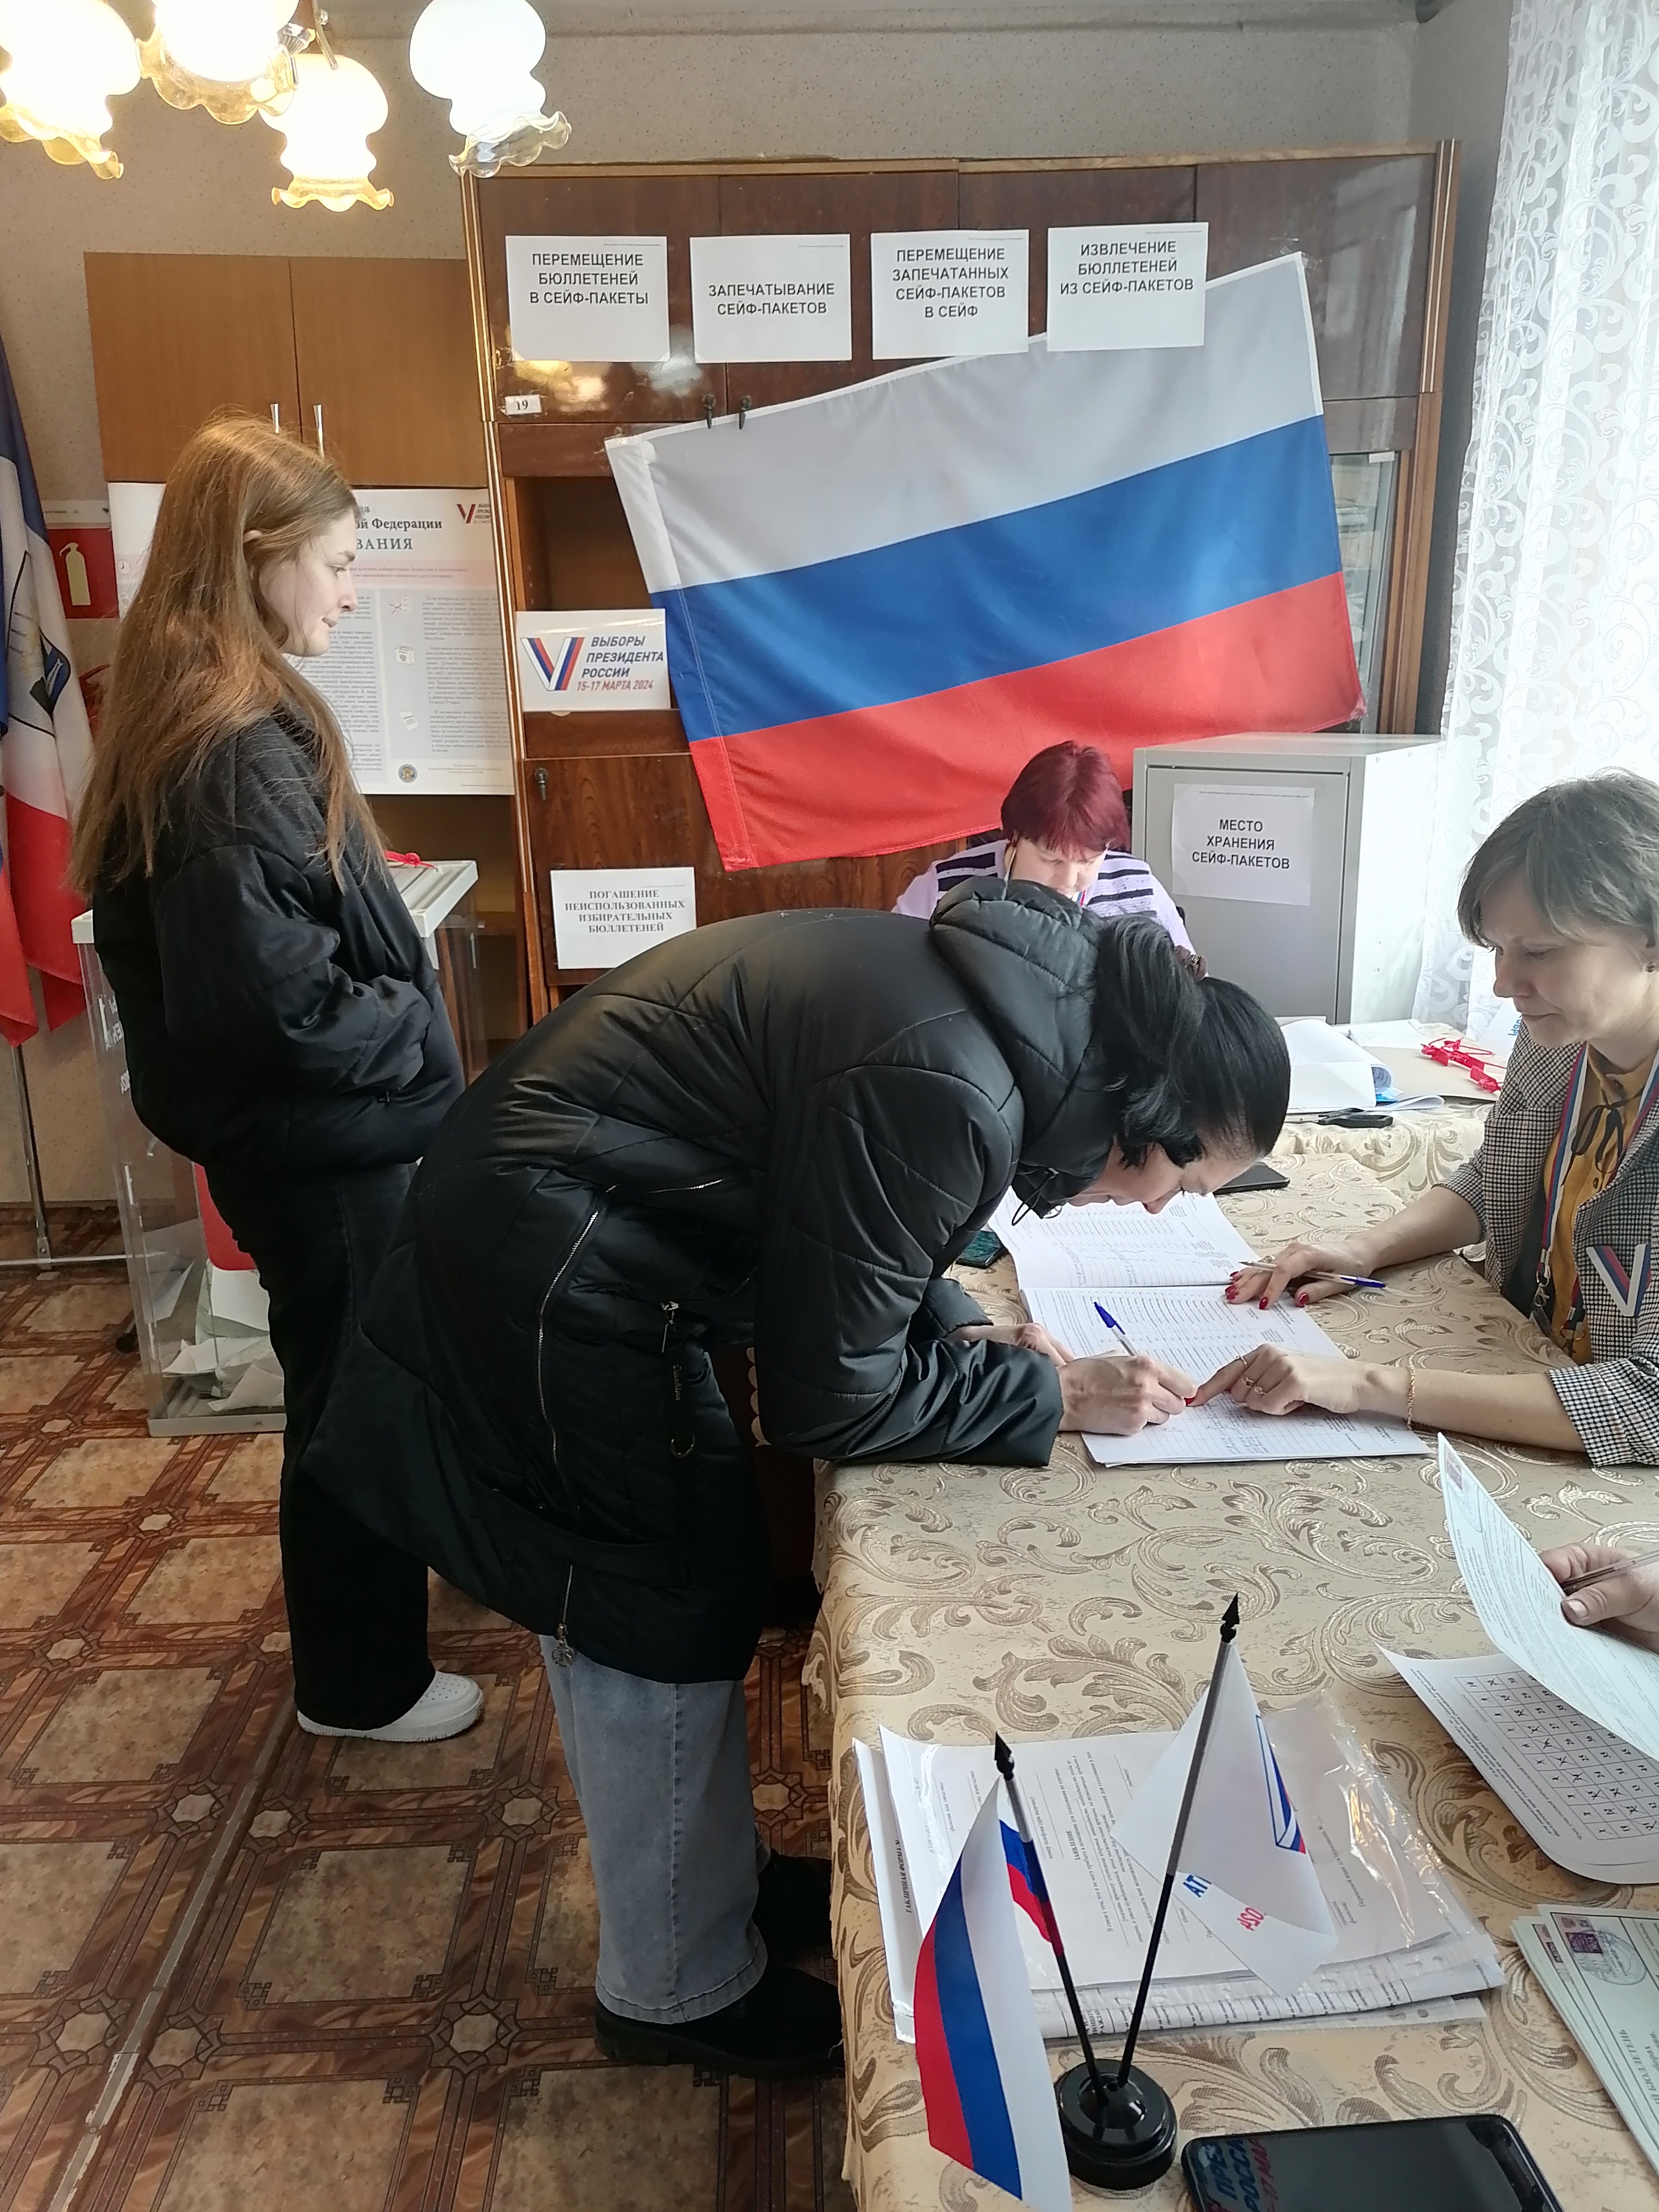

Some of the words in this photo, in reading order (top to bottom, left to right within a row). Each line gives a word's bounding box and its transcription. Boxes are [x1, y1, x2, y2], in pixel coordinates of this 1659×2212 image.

[896, 248, 1005, 263] ПЕРЕМЕЩЕНИЕ
[1081, 241, 1176, 256] ИЗВЛЕЧЕНИЕ
[532, 253, 643, 268] ПЕРЕМЕЩЕНИЕ
[1078, 257, 1177, 275] БЮЛЛЕТЕНЕЙ
[539, 270, 638, 285] БЮЛЛЕТЕНЕЙ
[893, 267, 1009, 281] ЗАПЕЧАТАННЫХ
[708, 283, 835, 297] ЗАПЕЧАТЫВАНИЕ
[896, 284, 1005, 300] СЕЙФ-ПАКЕТОВ
[1060, 283, 1078, 294] ИЗ
[1082, 278, 1193, 294] СЕЙФ-ПАКЕТОВ
[530, 293, 539, 304] В
[544, 289, 649, 304] СЕЙФ-ПАКЕТЫ
[717, 300, 827, 315] СЕЙФ-ПАКЕТОВ
[925, 306, 933, 317] В
[938, 302, 978, 317] СЕЙФ
[515, 400, 529, 410] 19
[372, 518, 443, 531] Федерации
[591, 636, 645, 647] ВЫБОРЫ
[586, 651, 664, 664] ПРЕЗИДЕНТА
[582, 668, 630, 678] РОССИИ
[577, 681, 601, 691] 15-17
[602, 680, 631, 691] МАРТА
[633, 680, 654, 690] 2024
[1219, 819, 1263, 832] МЕСТО
[1207, 836, 1275, 850] ХРАНЕНИЯ
[1192, 850, 1290, 869] СЕЙФ-ПАКЕТОВ
[589, 890, 659, 899] ПОГАШЕНИЕ
[565, 900, 685, 911] НЕИСПОЛЬЗОВАННЫХ
[579, 912, 672, 922] ИЗБИРАТЕЛЬНЫХ
[588, 922, 664, 933] БЮЛЛЕТЕНЕЙ
